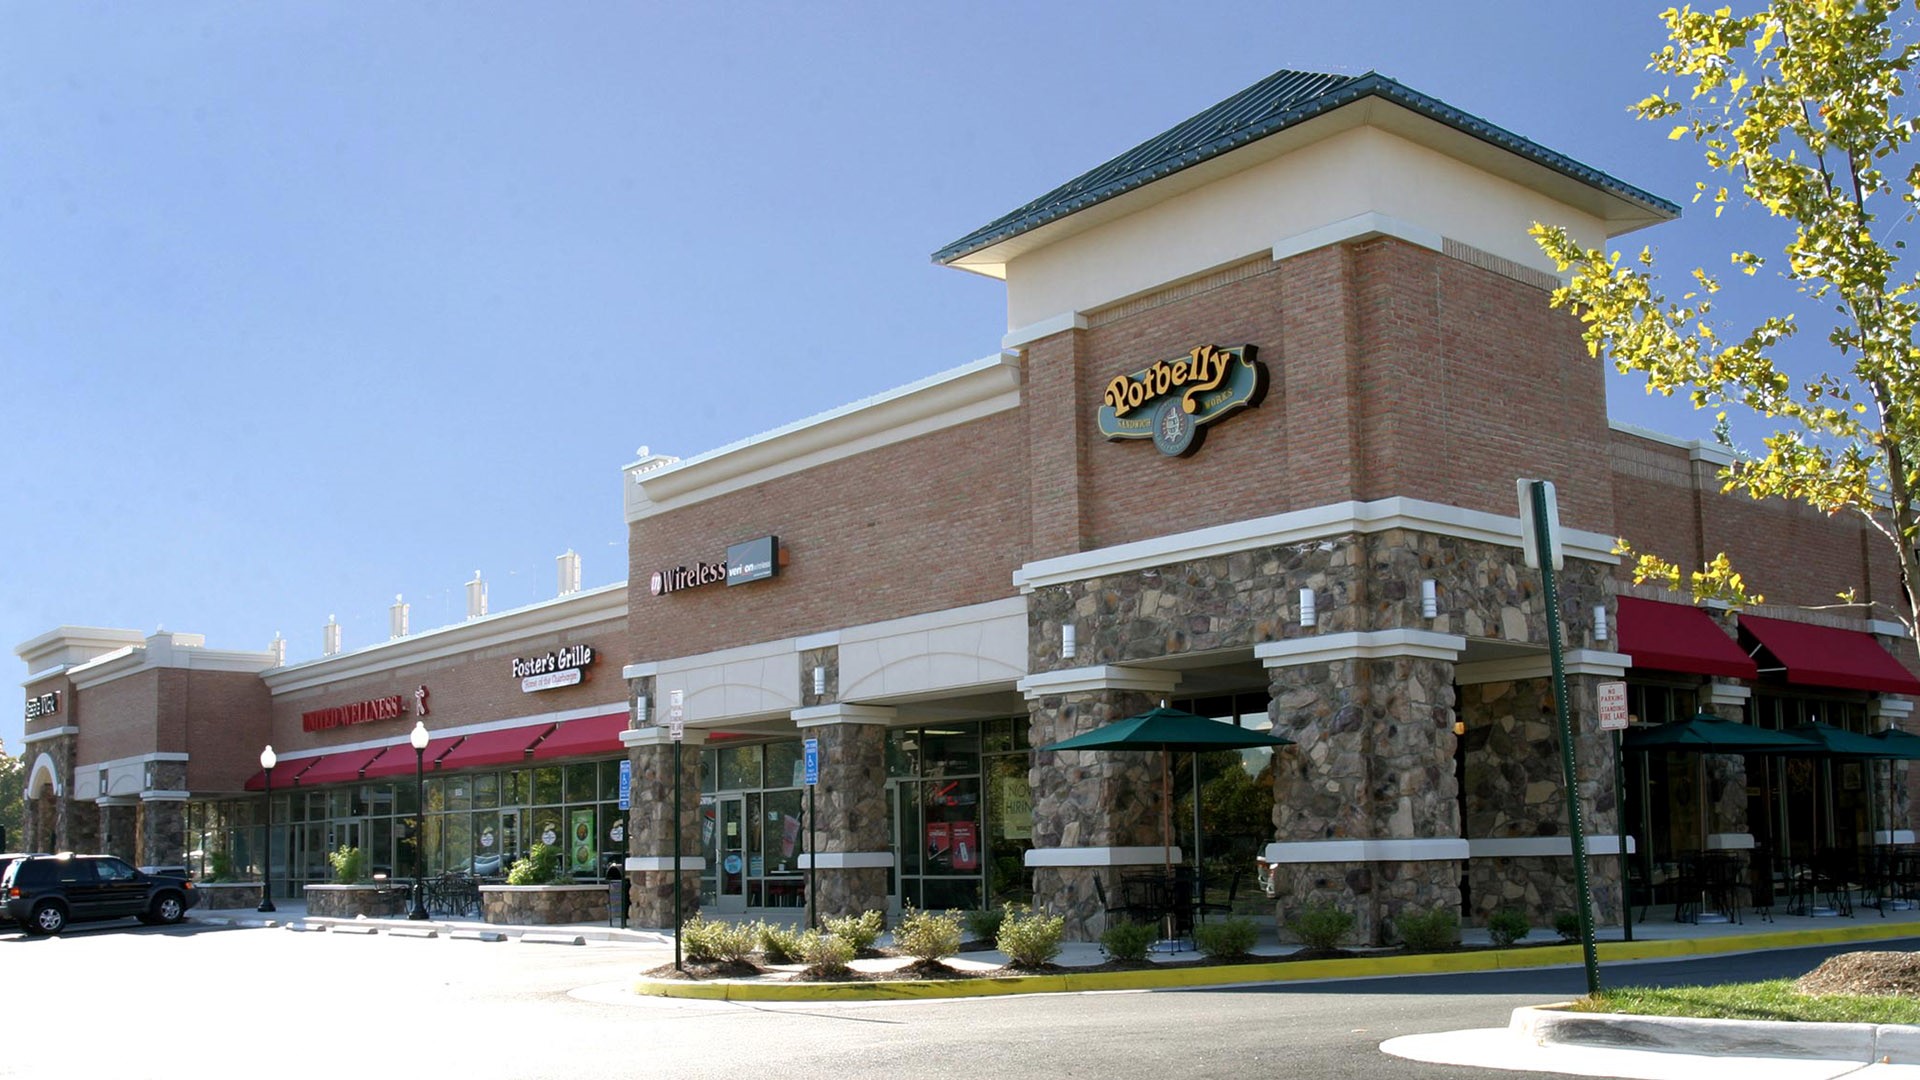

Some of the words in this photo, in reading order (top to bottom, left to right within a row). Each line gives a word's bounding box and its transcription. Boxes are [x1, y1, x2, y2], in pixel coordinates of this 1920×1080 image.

[1105, 345, 1230, 417] Potbelly
[1205, 388, 1233, 410] WORKS
[663, 562, 725, 593] Wireless
[512, 653, 555, 678] Foster's
[558, 645, 591, 669] Grille
[341, 696, 399, 727] WELLNESS
[1613, 712, 1626, 720] LANE
[1008, 784, 1031, 797] NO
[1006, 800, 1032, 814] HIRIN
